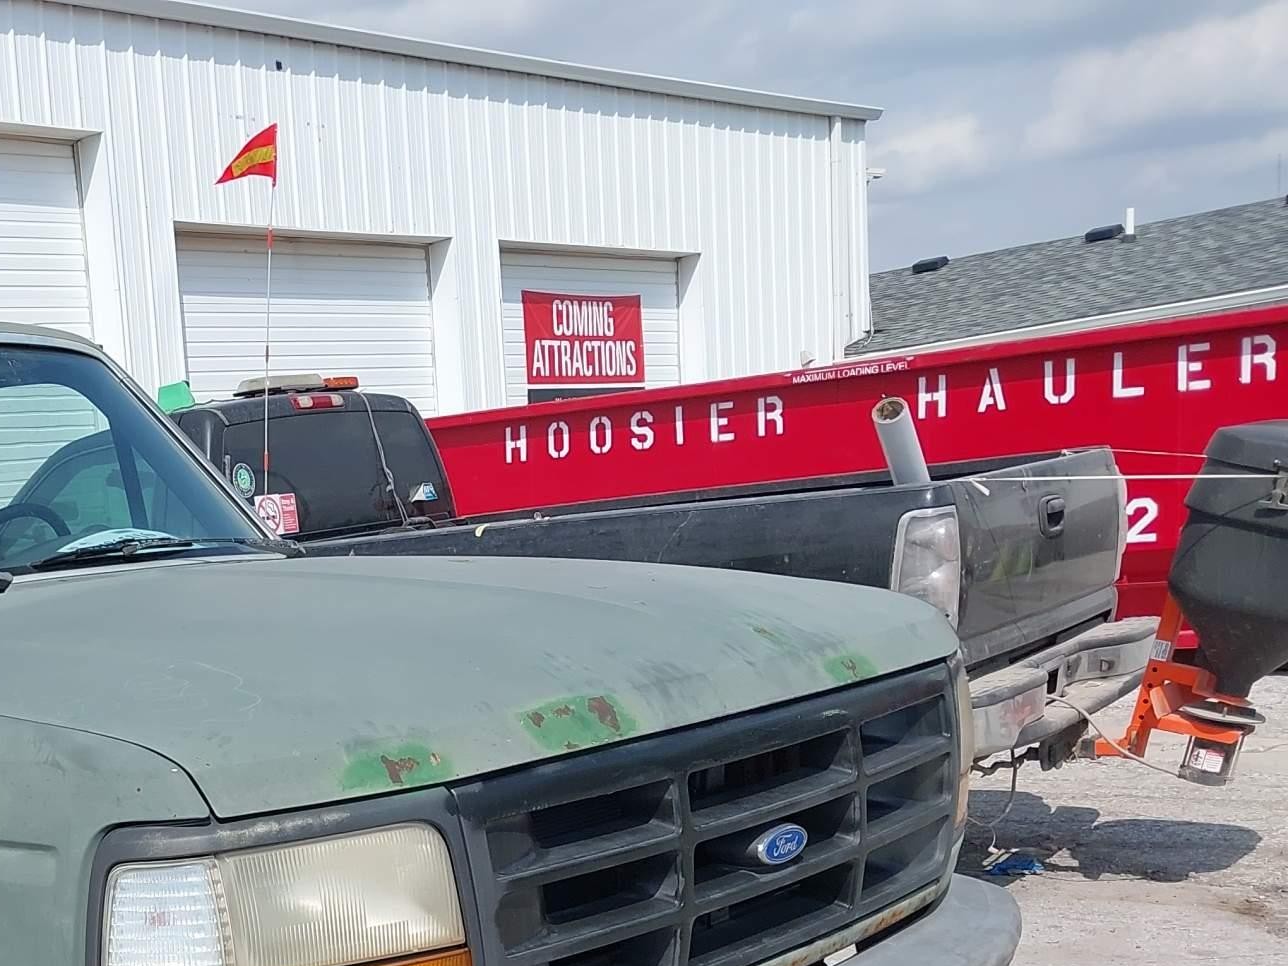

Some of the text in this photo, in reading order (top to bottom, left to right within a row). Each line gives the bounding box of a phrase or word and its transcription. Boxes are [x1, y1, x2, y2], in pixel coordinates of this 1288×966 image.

[552, 299, 615, 336] COMING
[532, 339, 637, 377] ATTRACTIONS
[792, 361, 911, 385] MAXIMUM LOADING LEVEL
[505, 334, 1278, 464] HOOSIER HAULER
[773, 833, 799, 857] Ford
